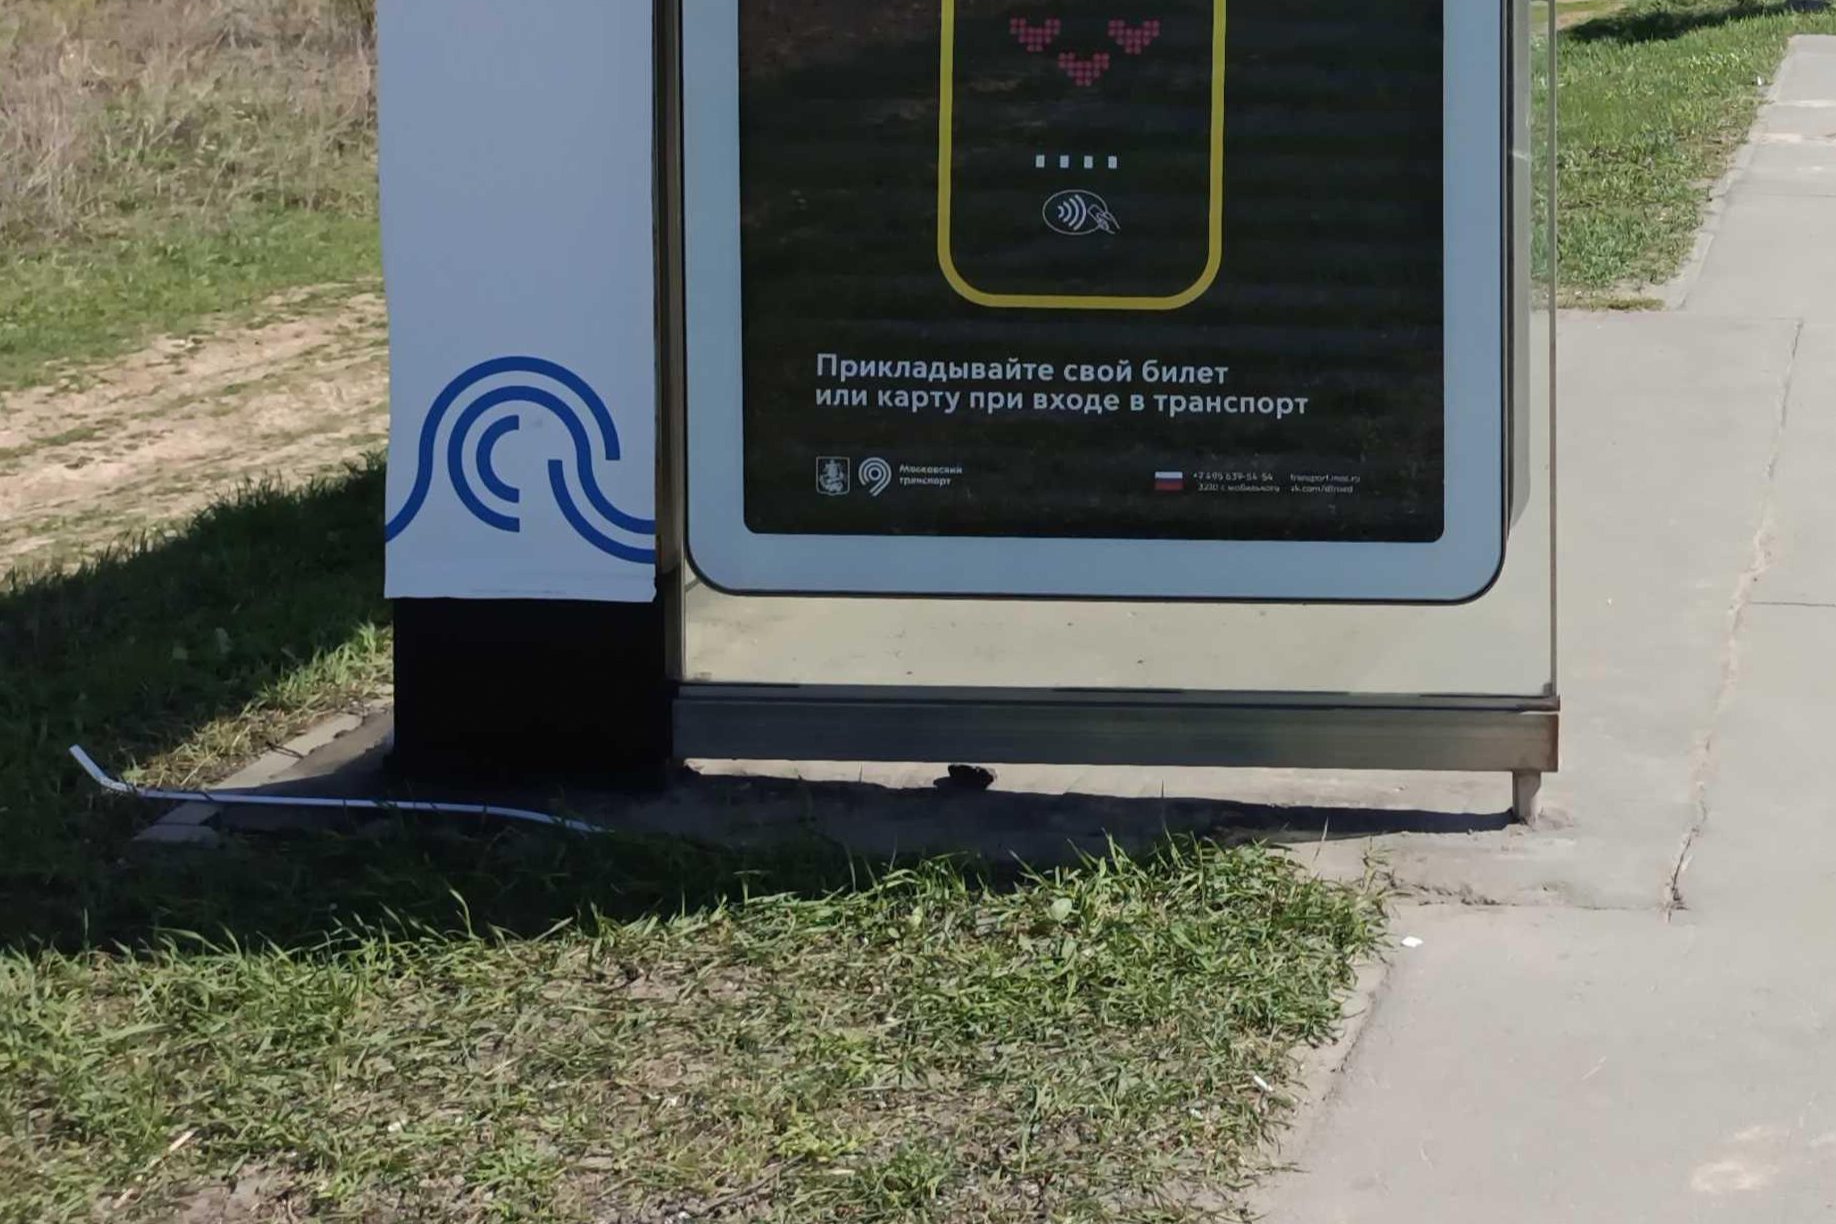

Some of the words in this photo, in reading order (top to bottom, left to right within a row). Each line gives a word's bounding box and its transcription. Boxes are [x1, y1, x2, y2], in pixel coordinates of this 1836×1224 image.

[817, 353, 1054, 383] Прикладывайте
[1063, 356, 1132, 382] свой
[1142, 358, 1229, 384] билет
[815, 388, 867, 406] или
[878, 389, 961, 414] карту
[970, 391, 1023, 414] при
[1033, 392, 1120, 415] входе
[1130, 394, 1145, 411] в
[1153, 394, 1309, 420] транспорт
